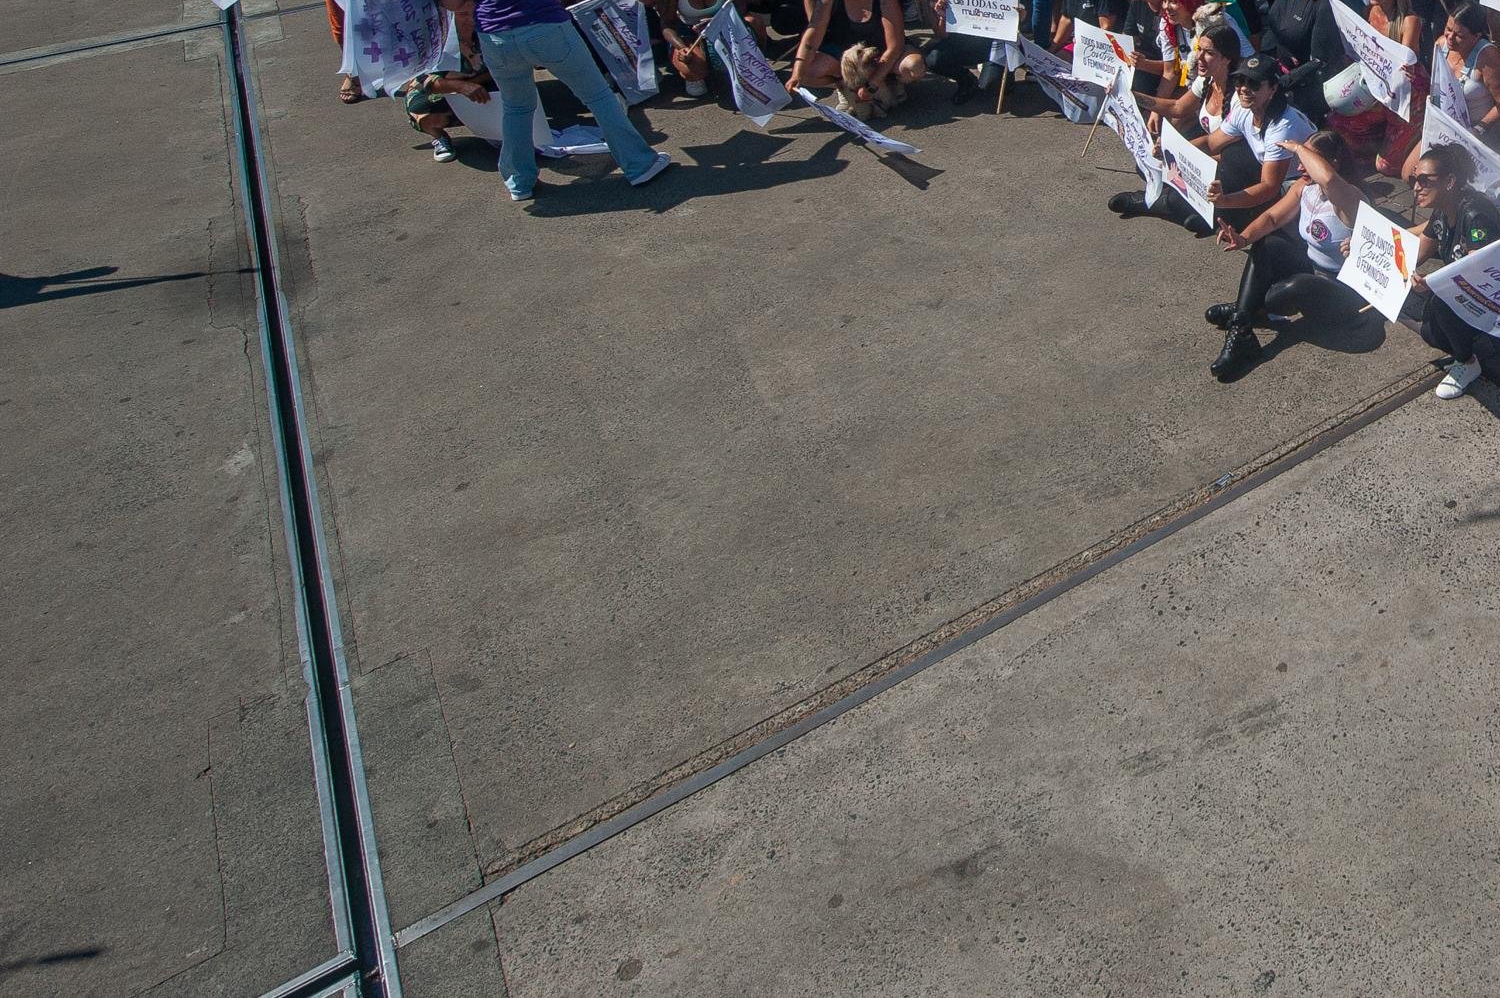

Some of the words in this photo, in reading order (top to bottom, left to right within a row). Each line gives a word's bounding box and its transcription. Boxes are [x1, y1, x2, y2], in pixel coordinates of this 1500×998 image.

[961, 8, 1005, 20] mulheres!
[1000, 4, 1011, 12] as
[1080, 35, 1097, 49] TODOS
[1083, 44, 1116, 64] Contra
[1361, 226, 1376, 244] TODOS
[1376, 236, 1394, 257] JUNTOS
[1360, 240, 1391, 271] Contra
[1478, 282, 1493, 292] E
